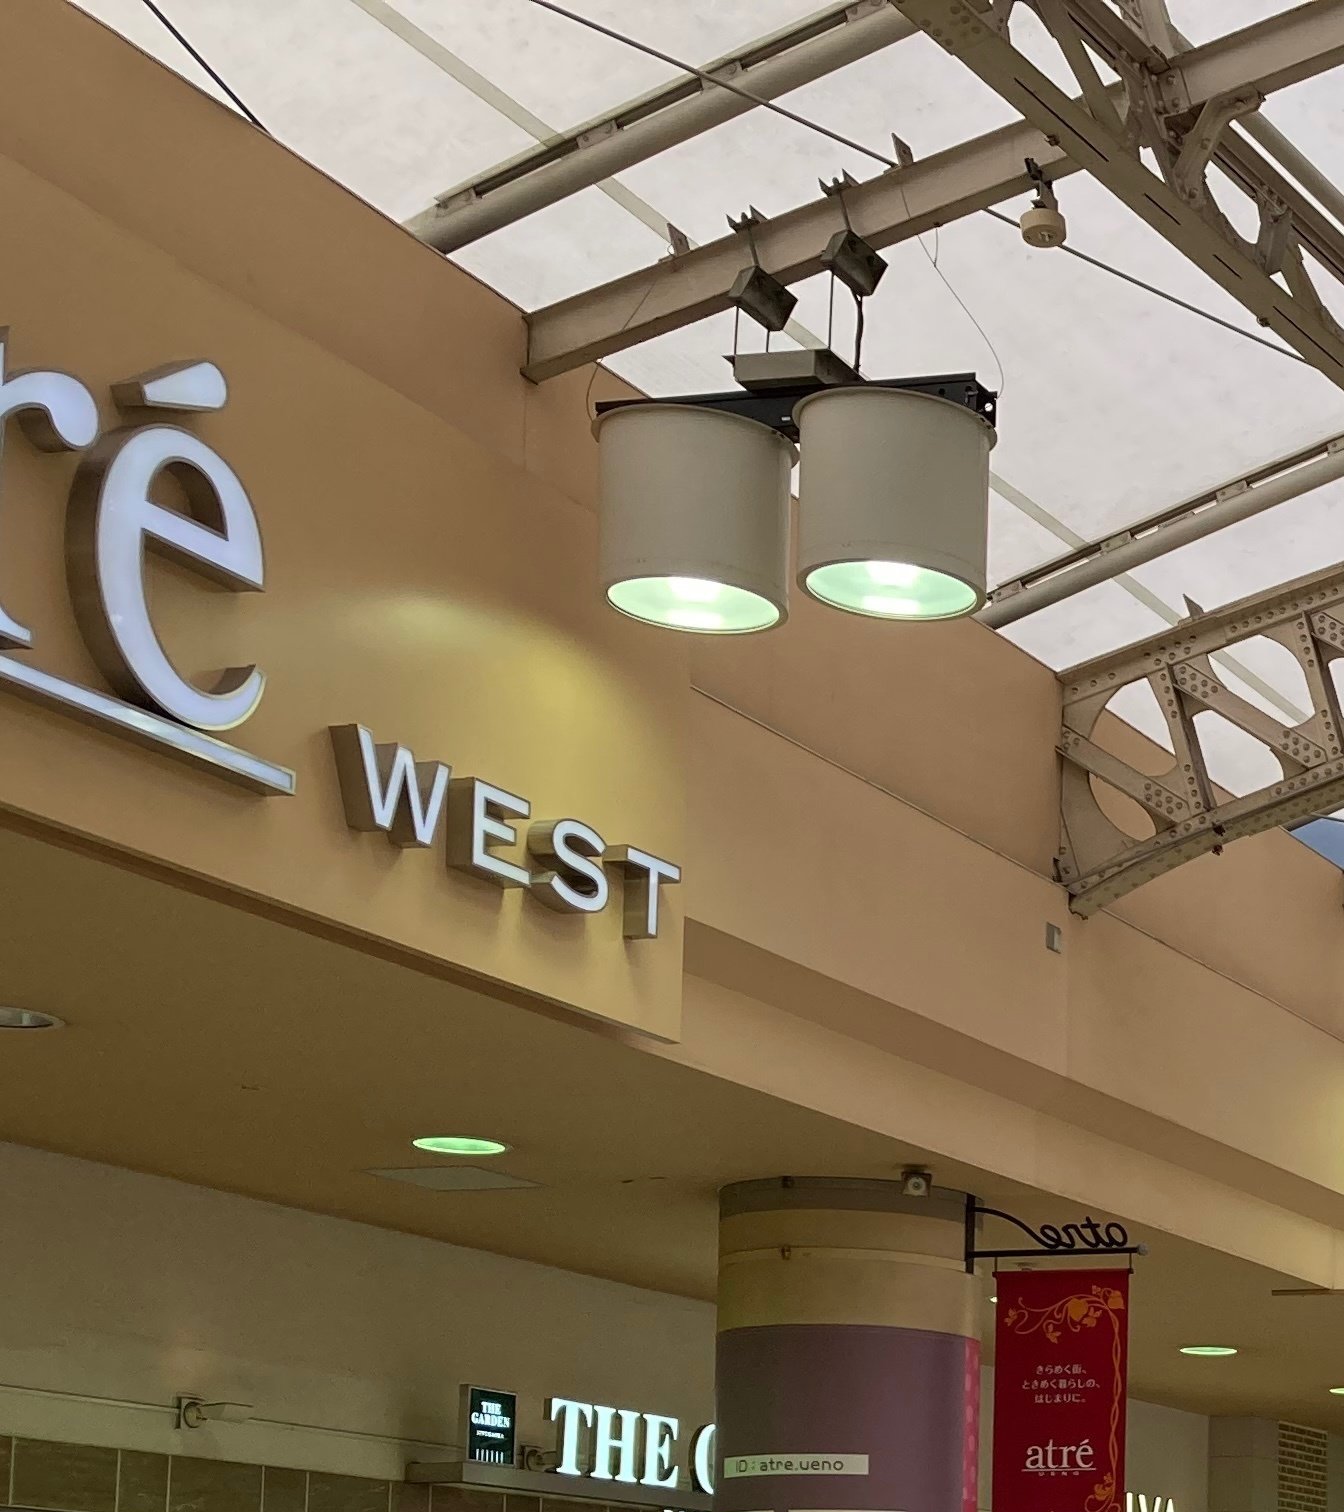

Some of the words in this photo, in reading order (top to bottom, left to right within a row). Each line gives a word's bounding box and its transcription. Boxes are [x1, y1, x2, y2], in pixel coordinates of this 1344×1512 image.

[330, 723, 682, 938] WEST
[471, 1411, 511, 1428] GARDEN
[480, 1401, 502, 1415] THE
[551, 1397, 680, 1488] THE
[1024, 1438, 1094, 1469] atré
